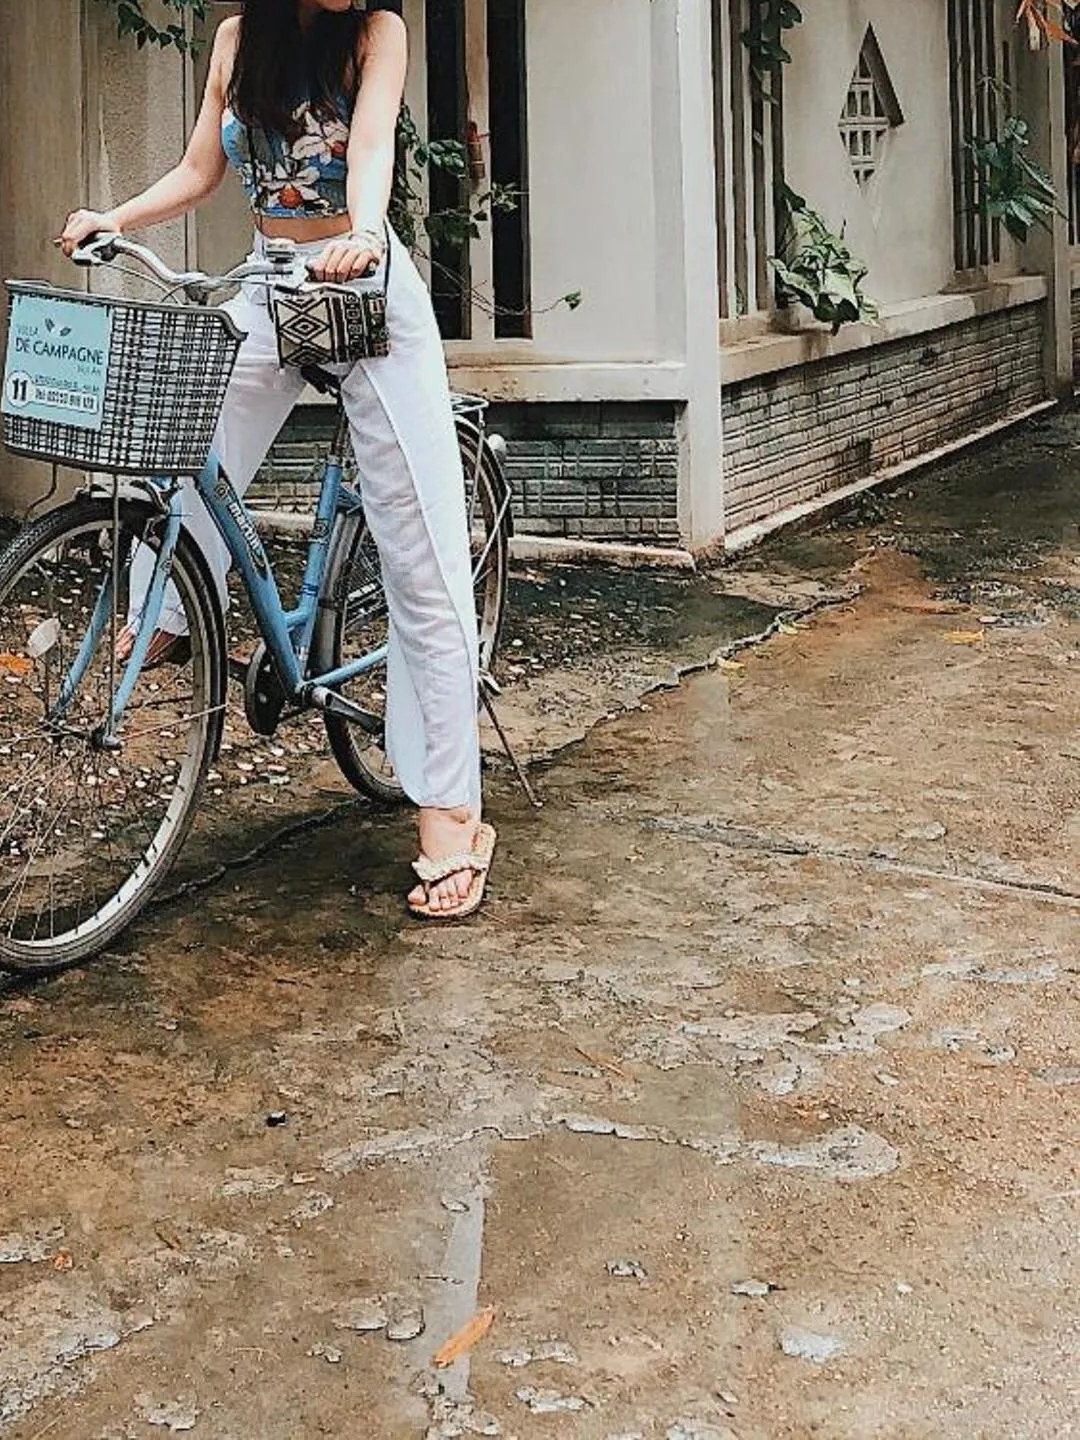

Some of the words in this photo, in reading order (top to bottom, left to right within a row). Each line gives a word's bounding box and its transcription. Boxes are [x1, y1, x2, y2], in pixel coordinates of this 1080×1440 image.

[16, 337, 30, 353] DE
[33, 340, 104, 365] CAMPAGNE
[12, 378, 27, 401] 11
[228, 502, 261, 550] martin
